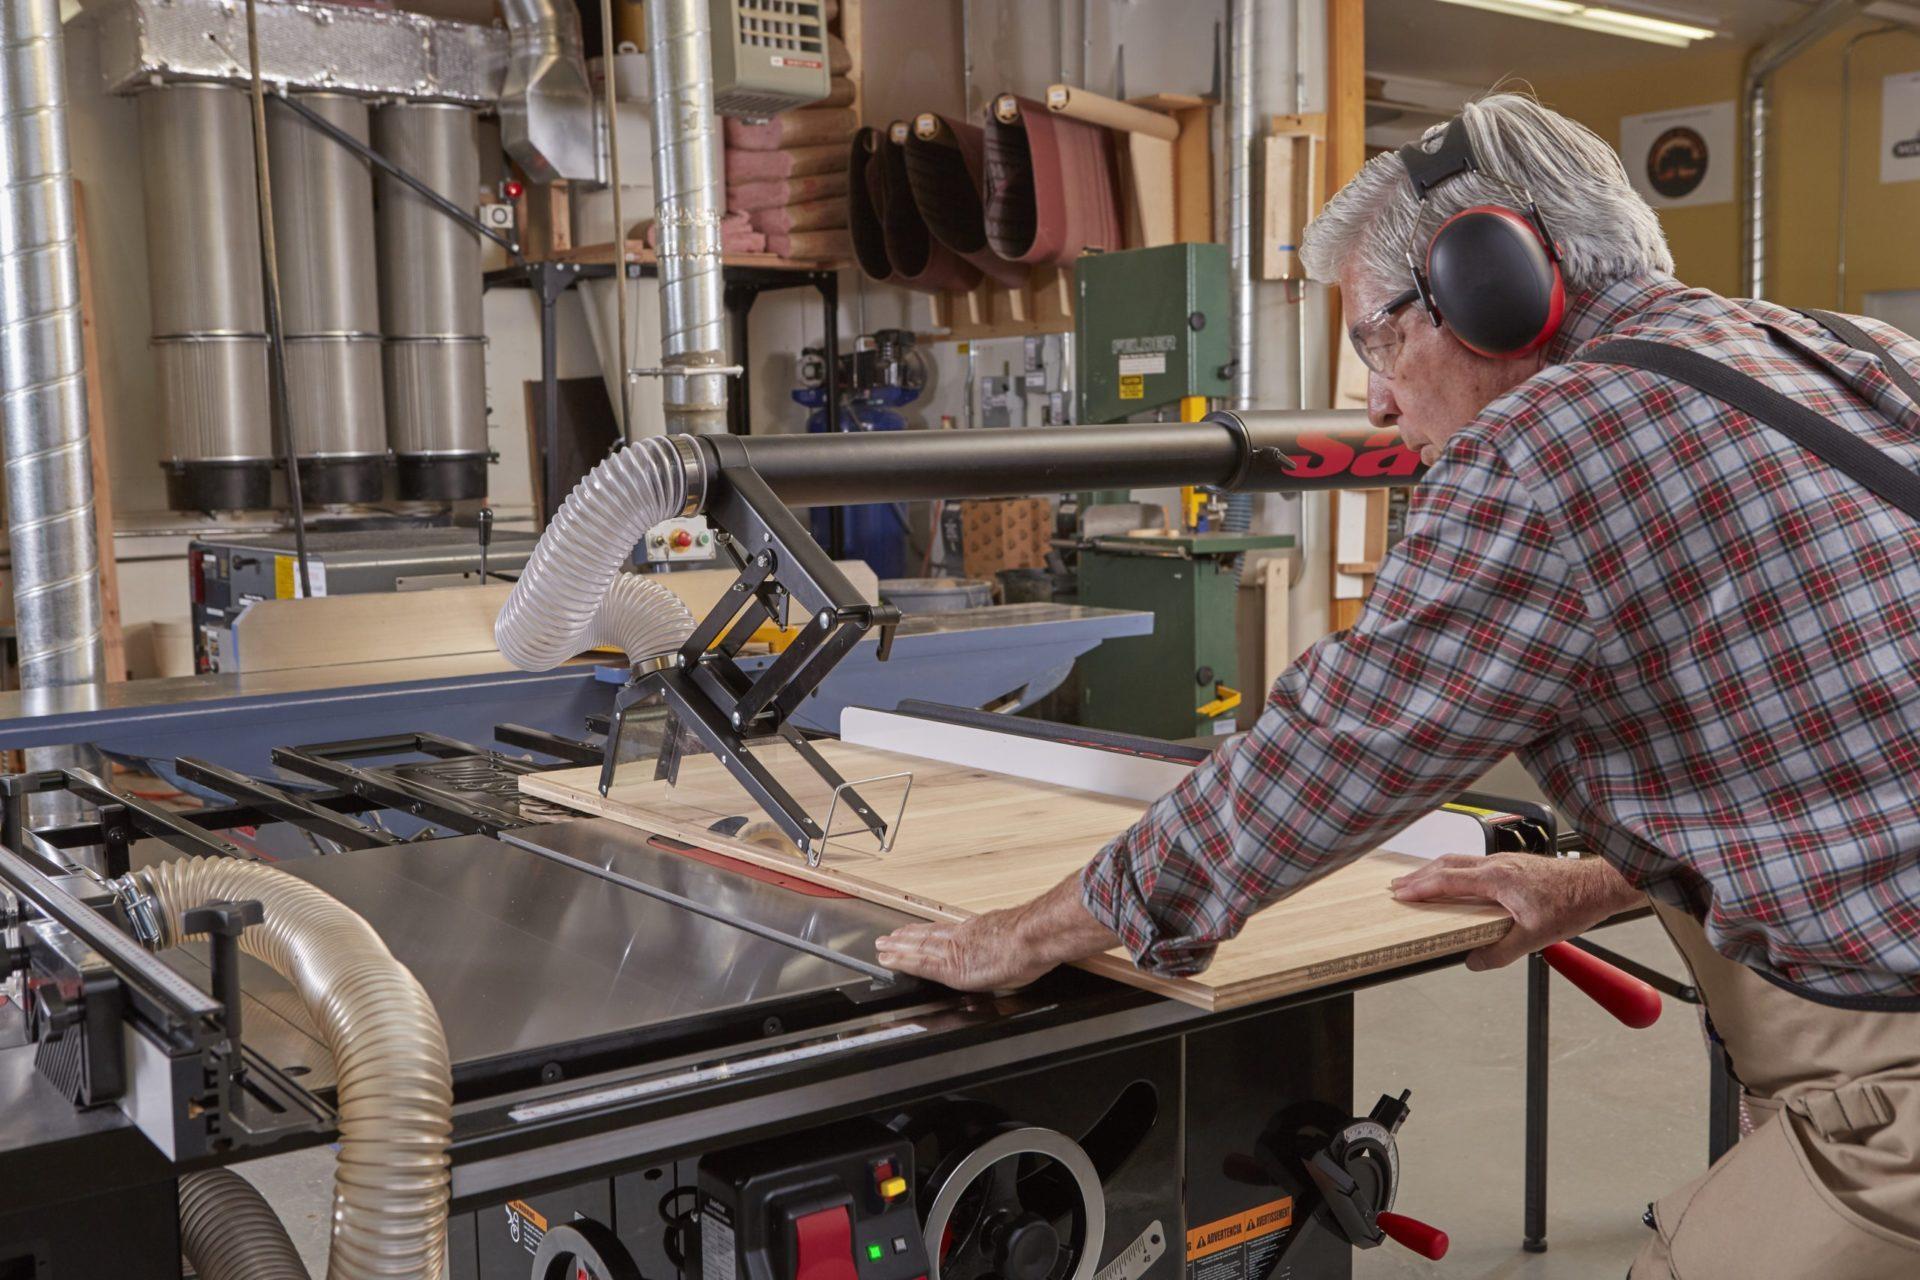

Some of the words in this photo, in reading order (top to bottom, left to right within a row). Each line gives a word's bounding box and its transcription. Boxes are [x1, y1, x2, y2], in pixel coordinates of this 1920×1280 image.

[1112, 335, 1176, 354] FELDER
[1281, 431, 1421, 478] Sa
[1256, 1206, 1290, 1227] AVERTISSEMENT
[1206, 1223, 1242, 1245] ADVERTENCIA
